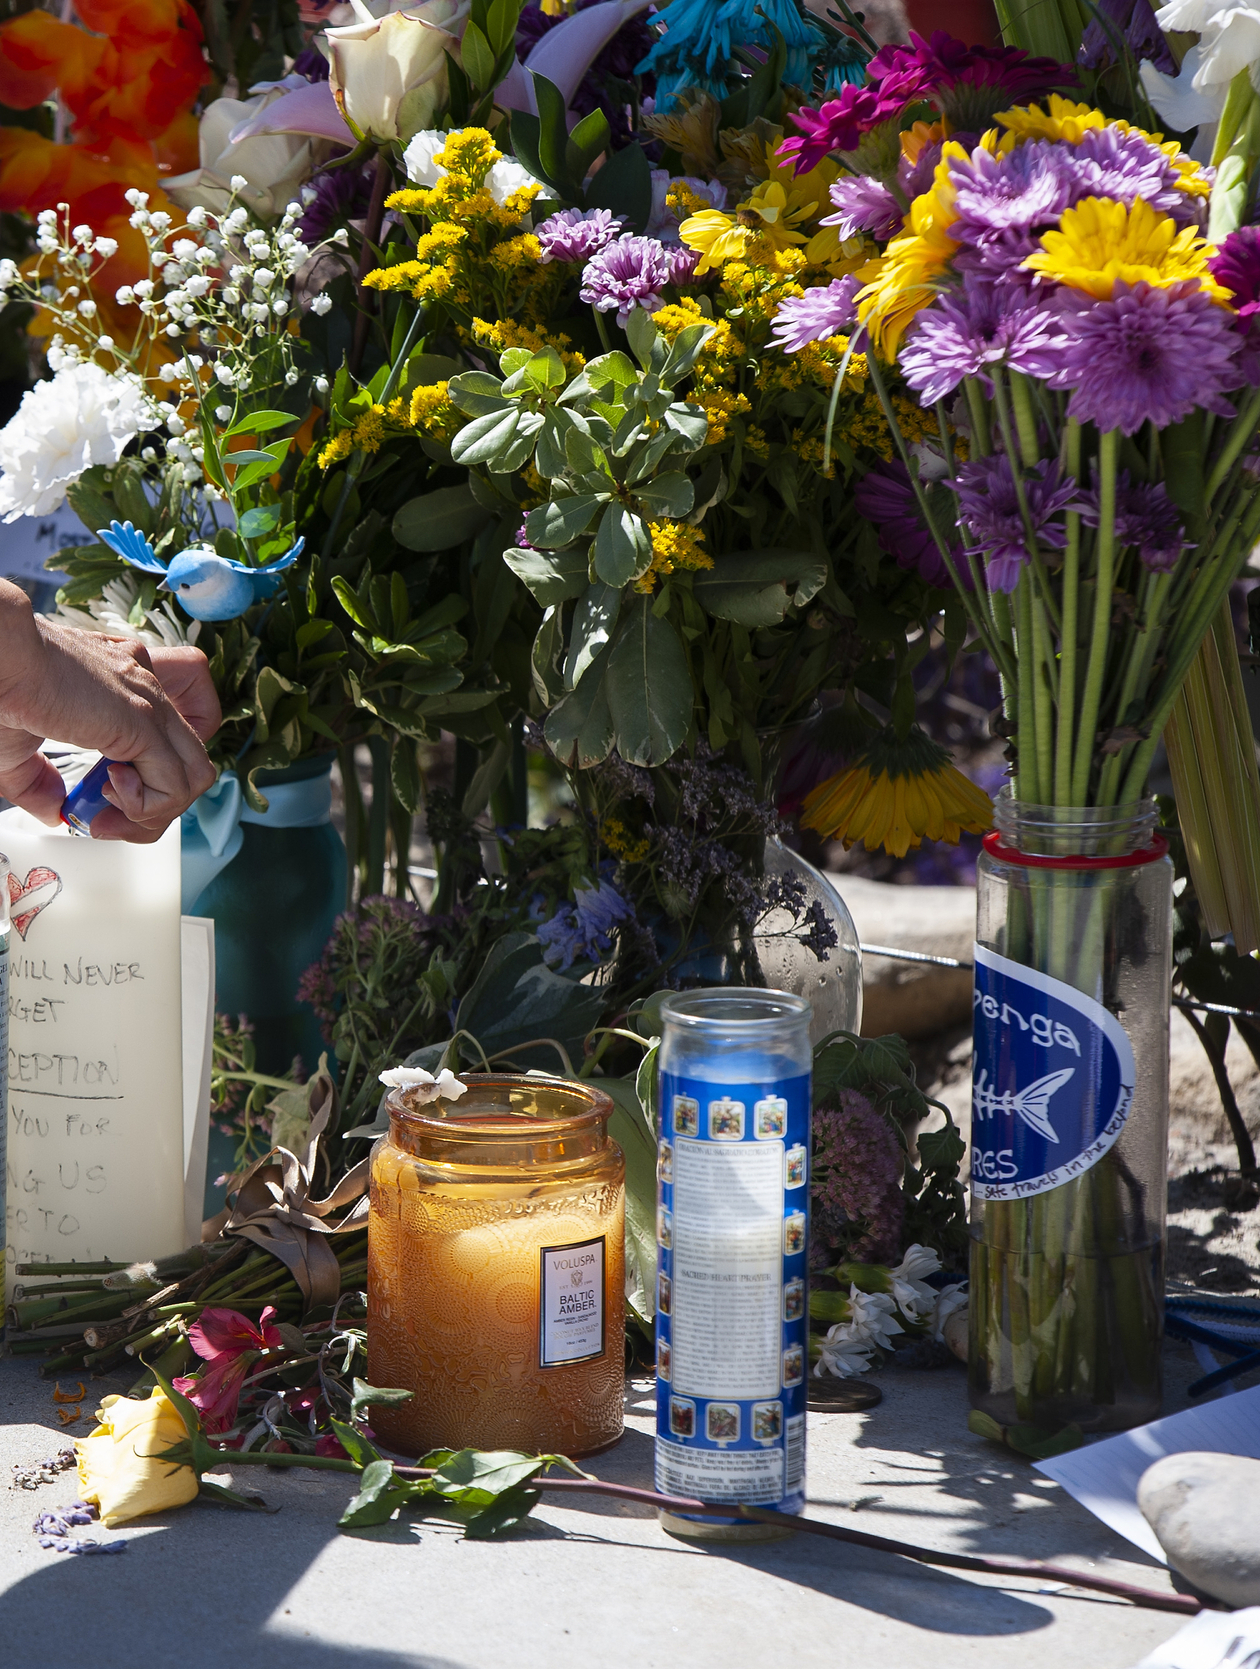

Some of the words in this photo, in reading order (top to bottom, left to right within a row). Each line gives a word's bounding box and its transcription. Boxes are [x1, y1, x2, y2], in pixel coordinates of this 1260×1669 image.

[64, 956, 145, 986] NEVER
[12, 1103, 49, 1137] YOU
[66, 1113, 117, 1138] FOR
[1012, 1172, 1059, 1197] travels
[1063, 1160, 1084, 1176] in
[1082, 1140, 1106, 1162] the
[1103, 1083, 1134, 1136] beyond
[58, 1160, 107, 1195] US
[553, 1254, 595, 1271] VOLUSPA
[560, 1290, 595, 1305] BALTIC
